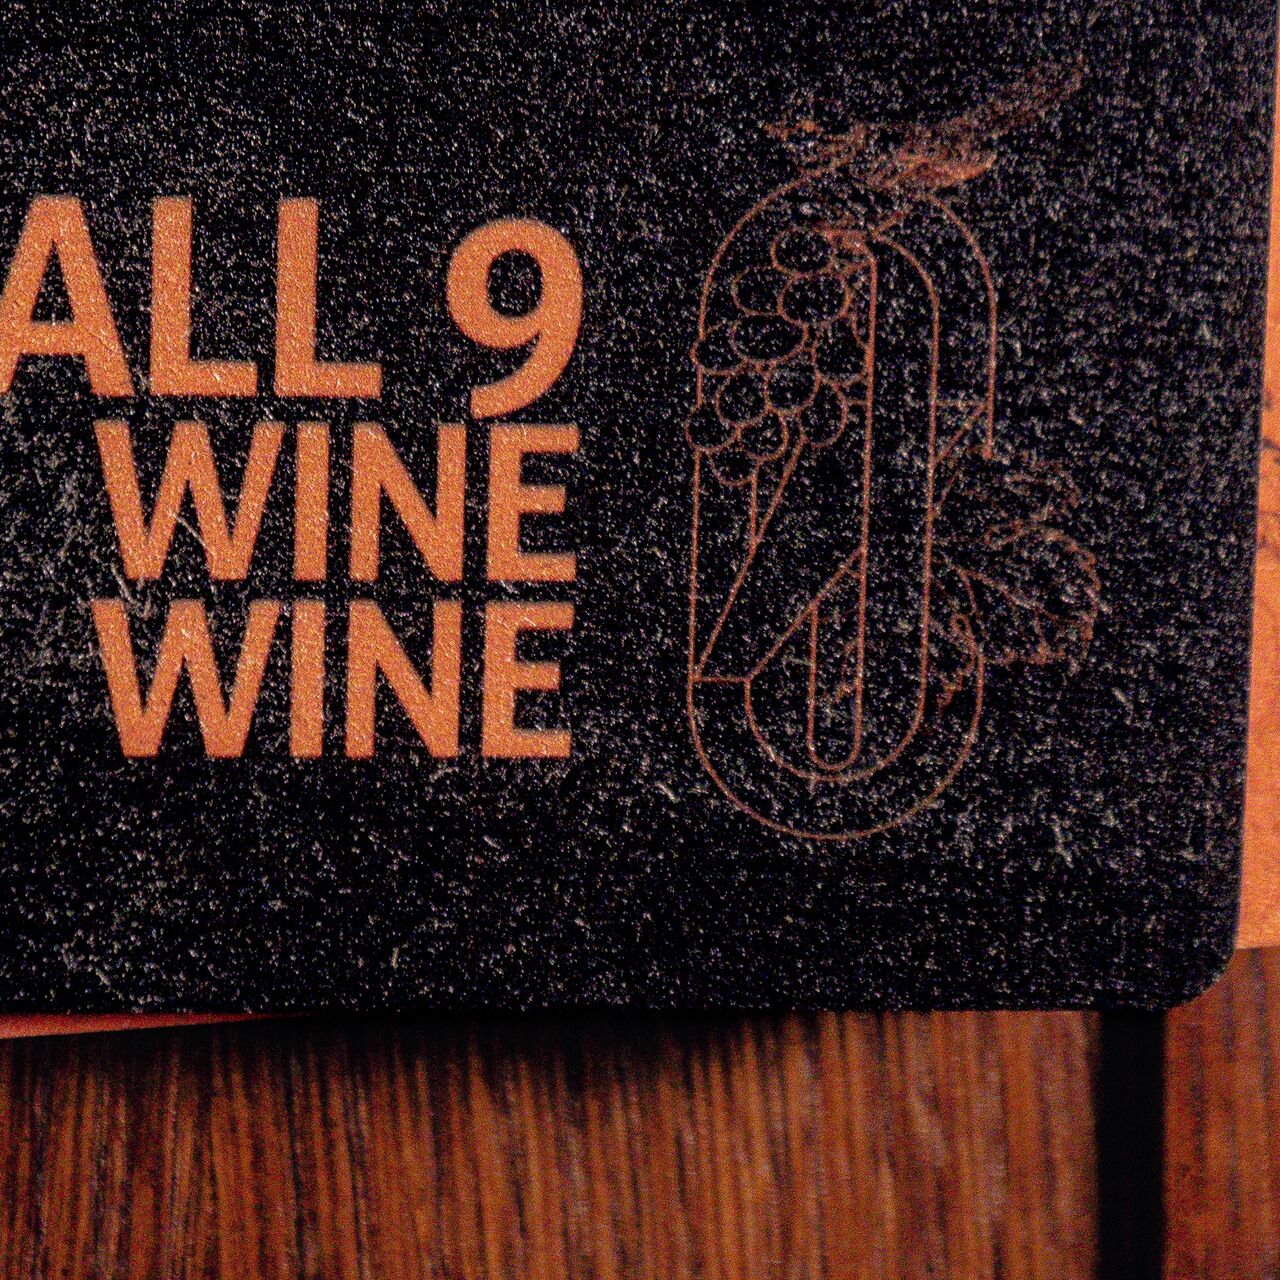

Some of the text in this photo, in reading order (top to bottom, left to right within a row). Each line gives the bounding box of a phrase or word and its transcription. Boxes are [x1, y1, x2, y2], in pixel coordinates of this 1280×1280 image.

[446, 219, 584, 419] 9
[94, 421, 580, 583] WINE
[90, 599, 574, 760] WINE
